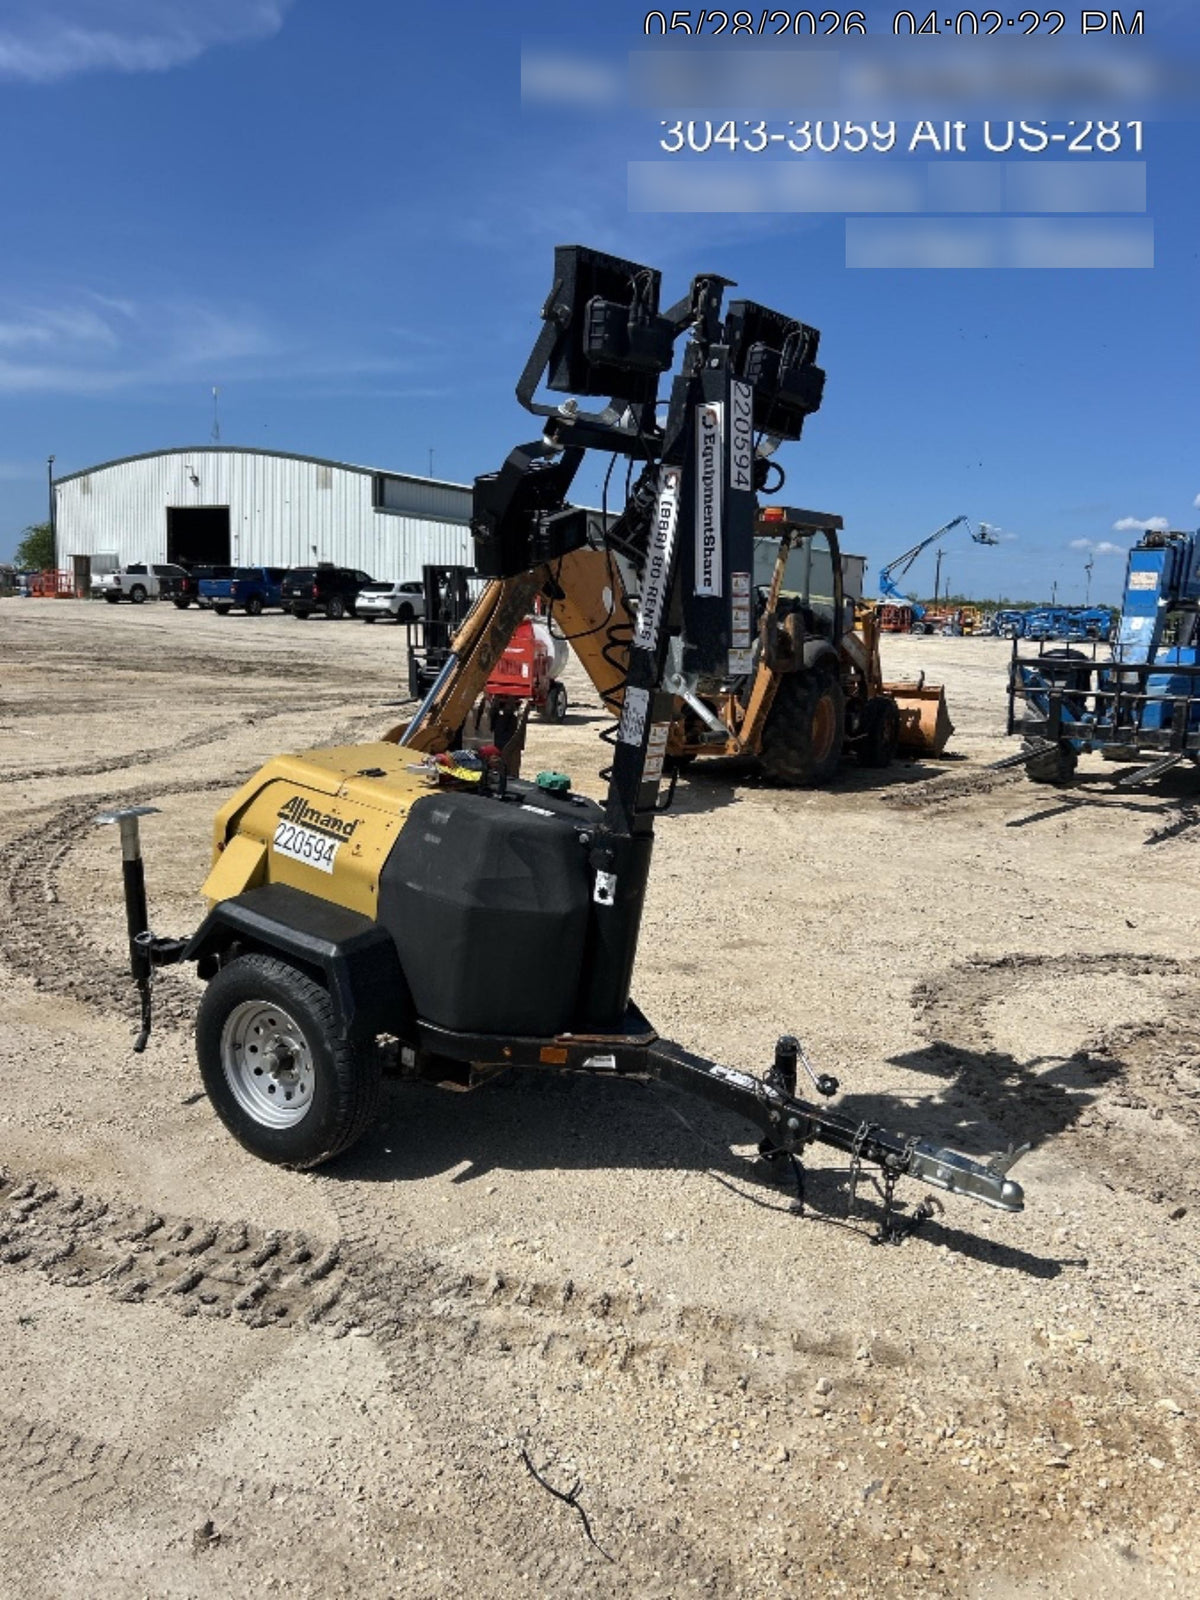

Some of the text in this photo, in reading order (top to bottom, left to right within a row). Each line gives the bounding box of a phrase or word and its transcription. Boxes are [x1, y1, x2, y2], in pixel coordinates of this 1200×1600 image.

[734, 382, 752, 487] 220594
[701, 433, 716, 588] EquipmentShare
[274, 822, 336, 866] 220594
[280, 796, 358, 837] Allmand
